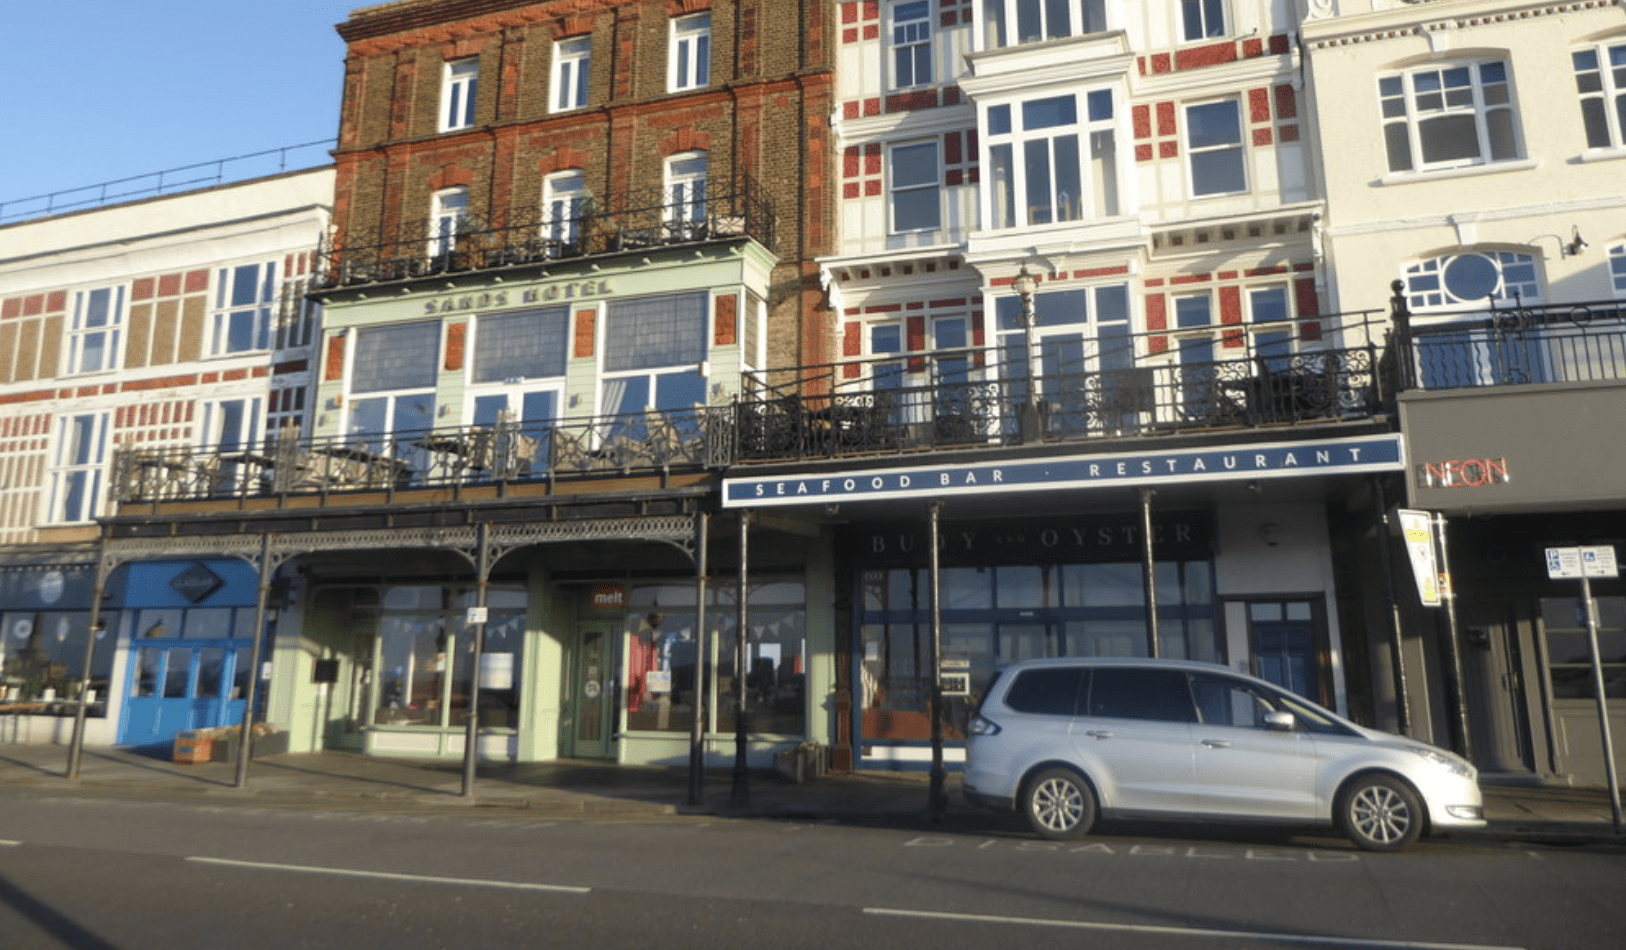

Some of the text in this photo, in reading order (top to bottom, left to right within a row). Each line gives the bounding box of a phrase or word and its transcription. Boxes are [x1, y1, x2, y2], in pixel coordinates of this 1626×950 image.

[424, 279, 614, 314] SANDS HOTEL
[755, 447, 1363, 498] SEAFOOD BAR RESTAURANT
[1425, 457, 1510, 488] NEON
[1040, 522, 1193, 548] OYSTER
[594, 591, 623, 604] melt
[903, 836, 1361, 863] DISABLED
